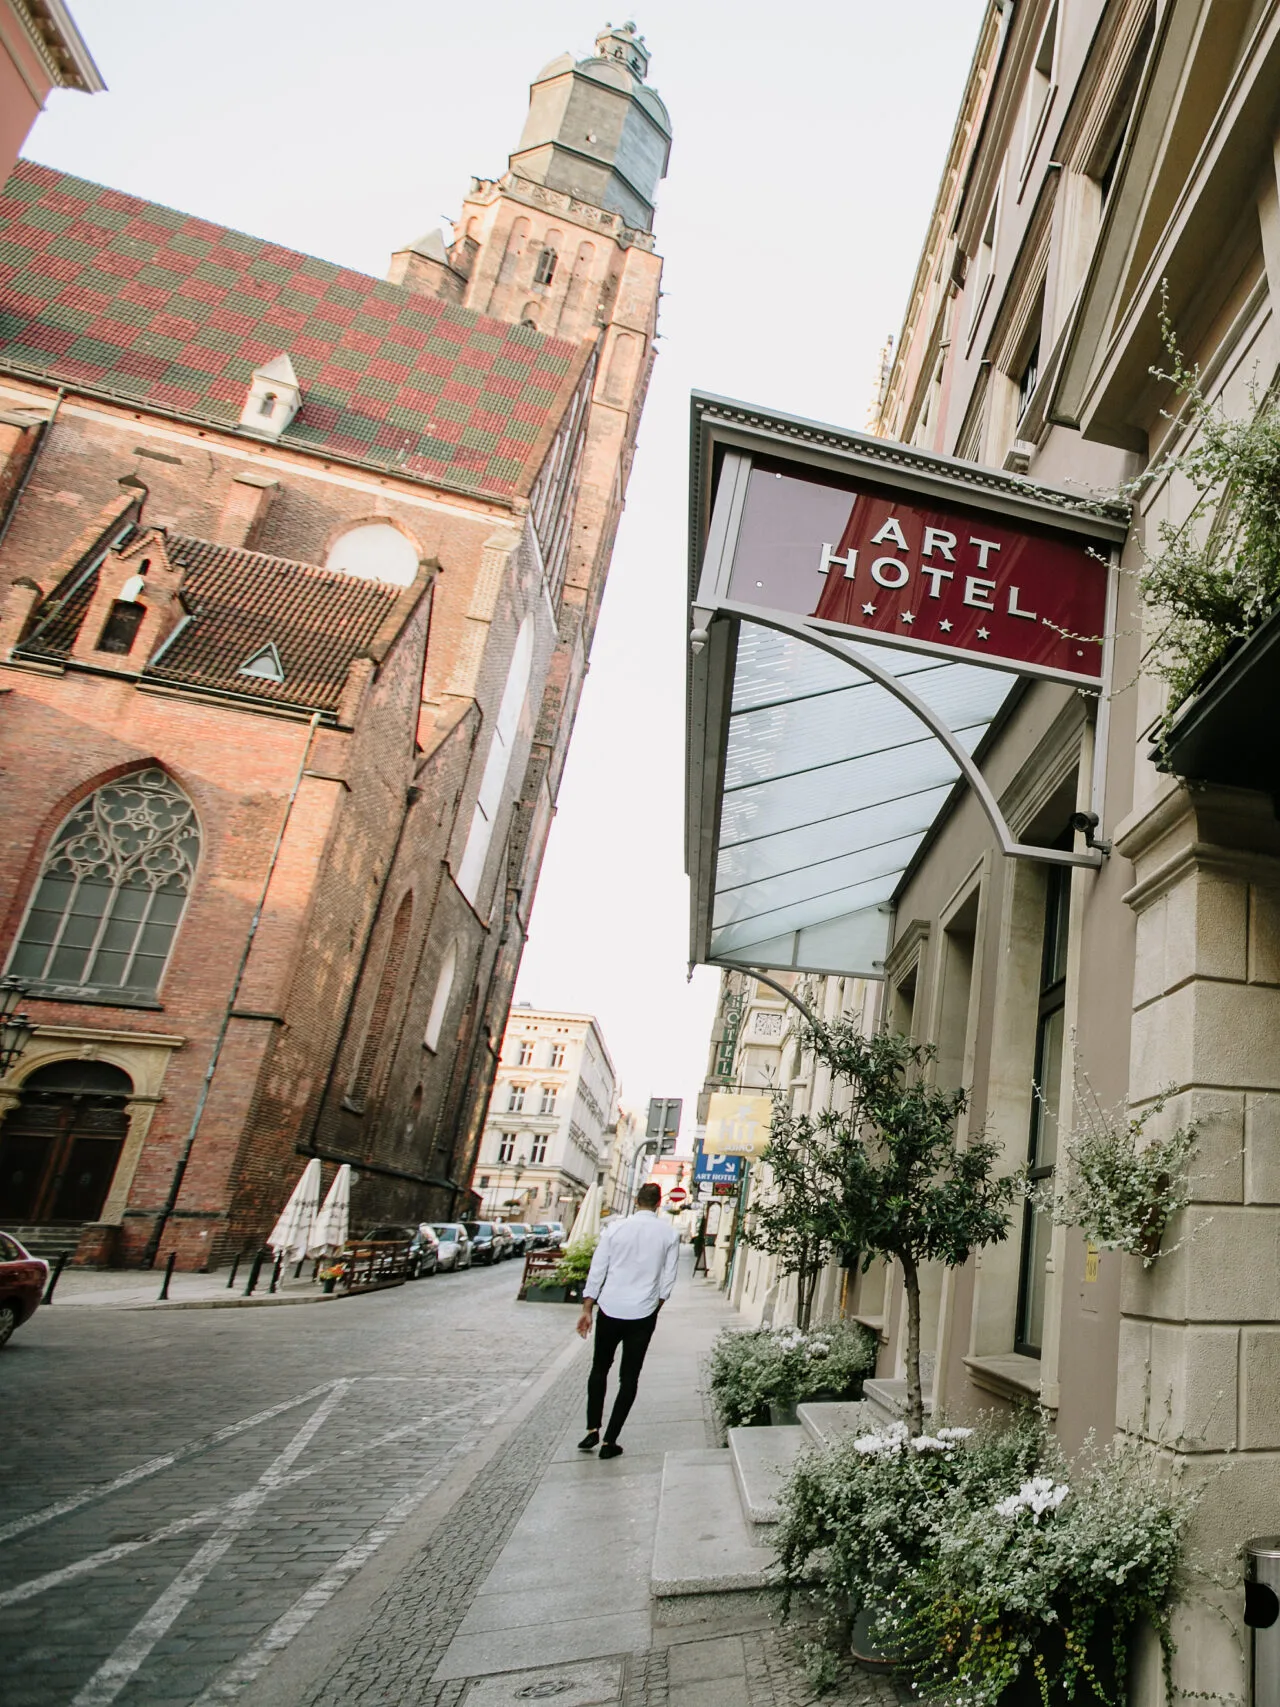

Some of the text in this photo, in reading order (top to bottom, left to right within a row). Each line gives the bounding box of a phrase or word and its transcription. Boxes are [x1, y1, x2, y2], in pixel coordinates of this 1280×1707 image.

[870, 516, 1001, 569] ART
[817, 542, 1037, 620] HOTEL
[721, 996, 741, 1074] HOTEL
[706, 1154, 726, 1171] P
[712, 1174, 737, 1182] HOTEL
